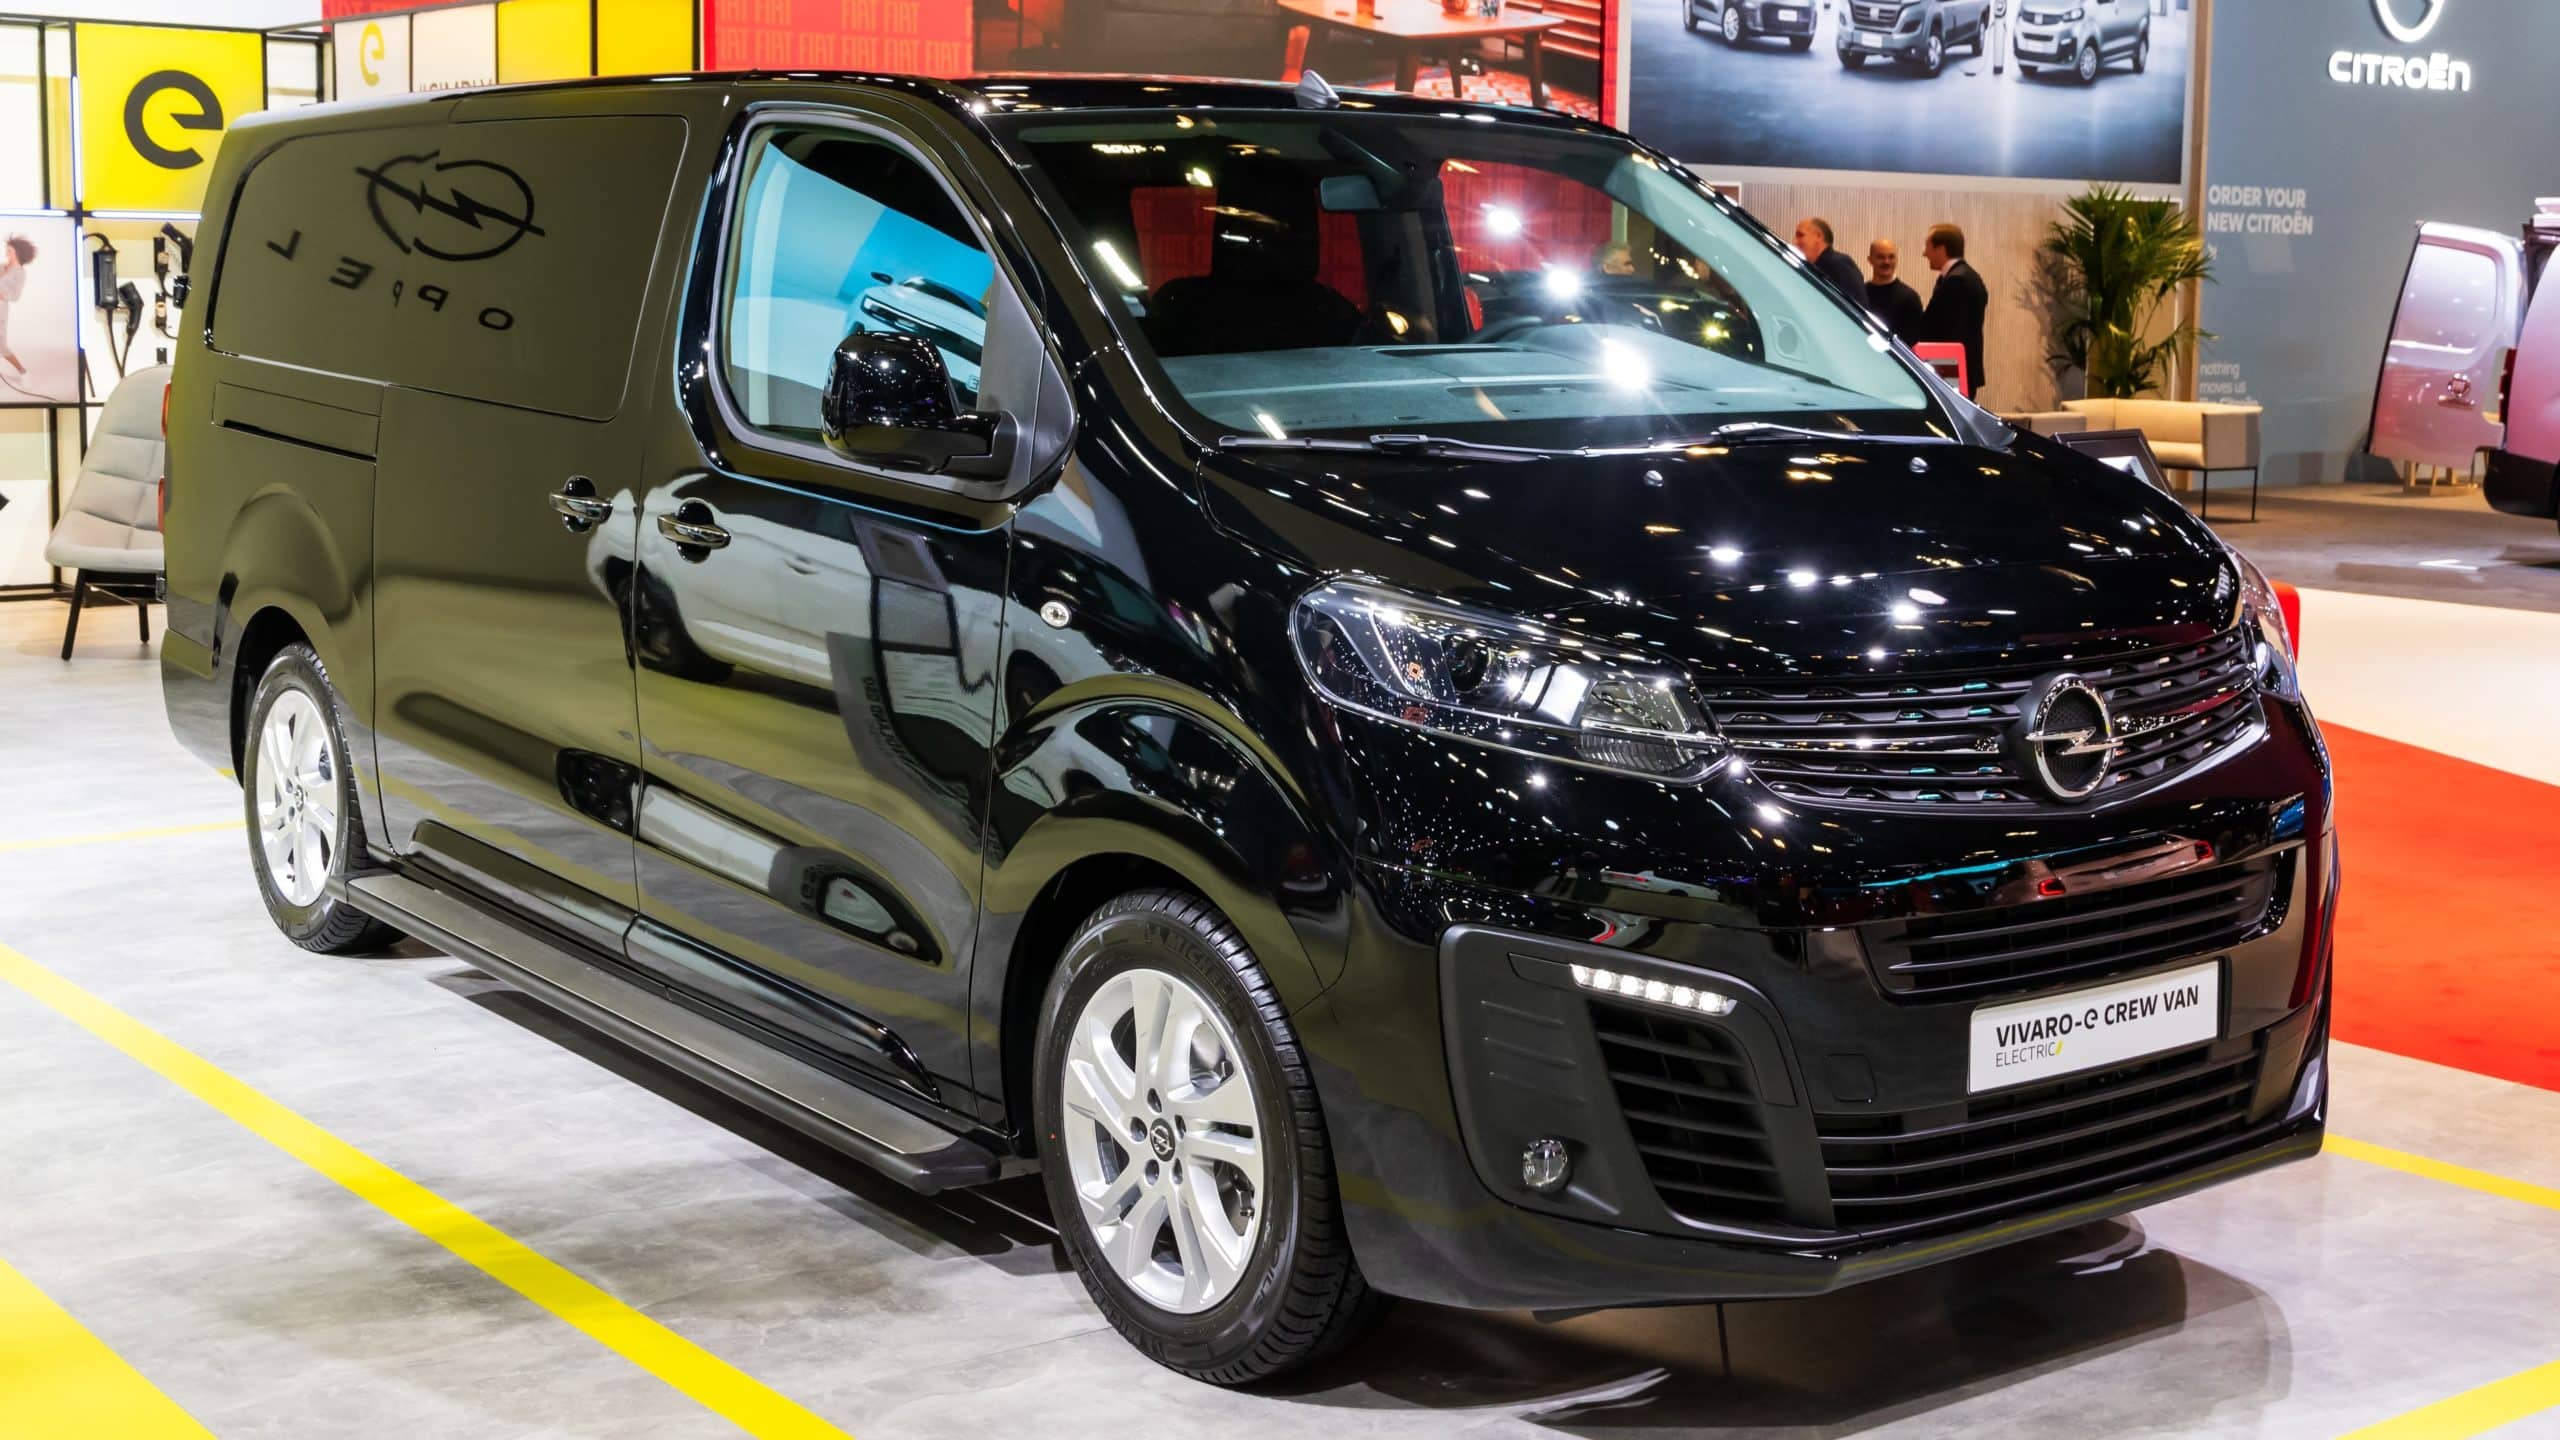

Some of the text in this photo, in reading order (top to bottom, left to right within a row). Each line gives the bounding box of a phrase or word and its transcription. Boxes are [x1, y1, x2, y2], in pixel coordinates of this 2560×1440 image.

[2208, 185, 2307, 209] ORDER YOUR
[2207, 209, 2314, 235] NEW CITROËN
[2104, 995, 2157, 1025] CREW
[2163, 985, 2199, 1012] VAN
